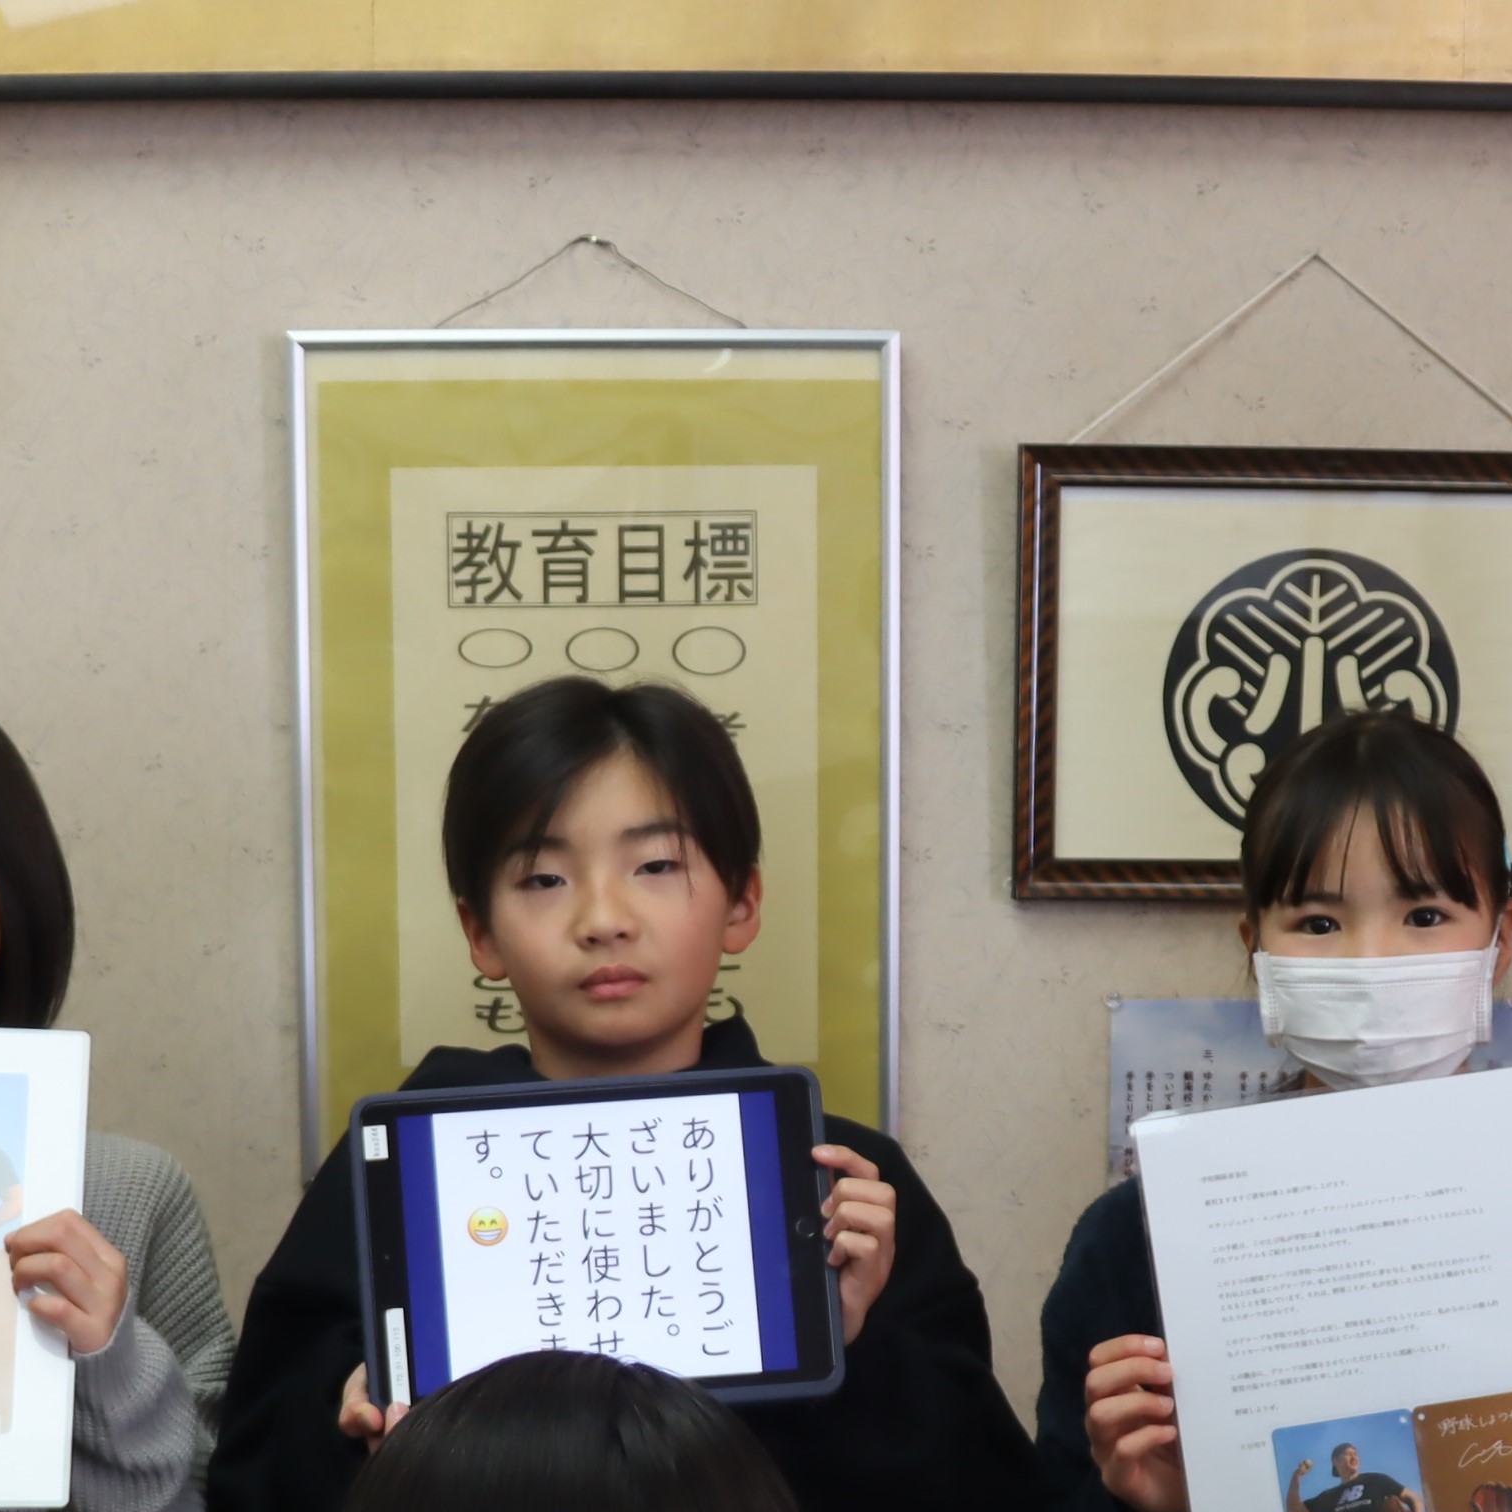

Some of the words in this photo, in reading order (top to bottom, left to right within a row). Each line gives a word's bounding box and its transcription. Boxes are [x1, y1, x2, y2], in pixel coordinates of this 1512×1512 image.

[451, 519, 754, 605] 教育目標
[466, 1129, 503, 1179] す。
[572, 1122, 625, 1353] 大切に使わせ
[629, 1117, 681, 1337] ざいました。
[682, 1117, 734, 1356] ありがとうご
